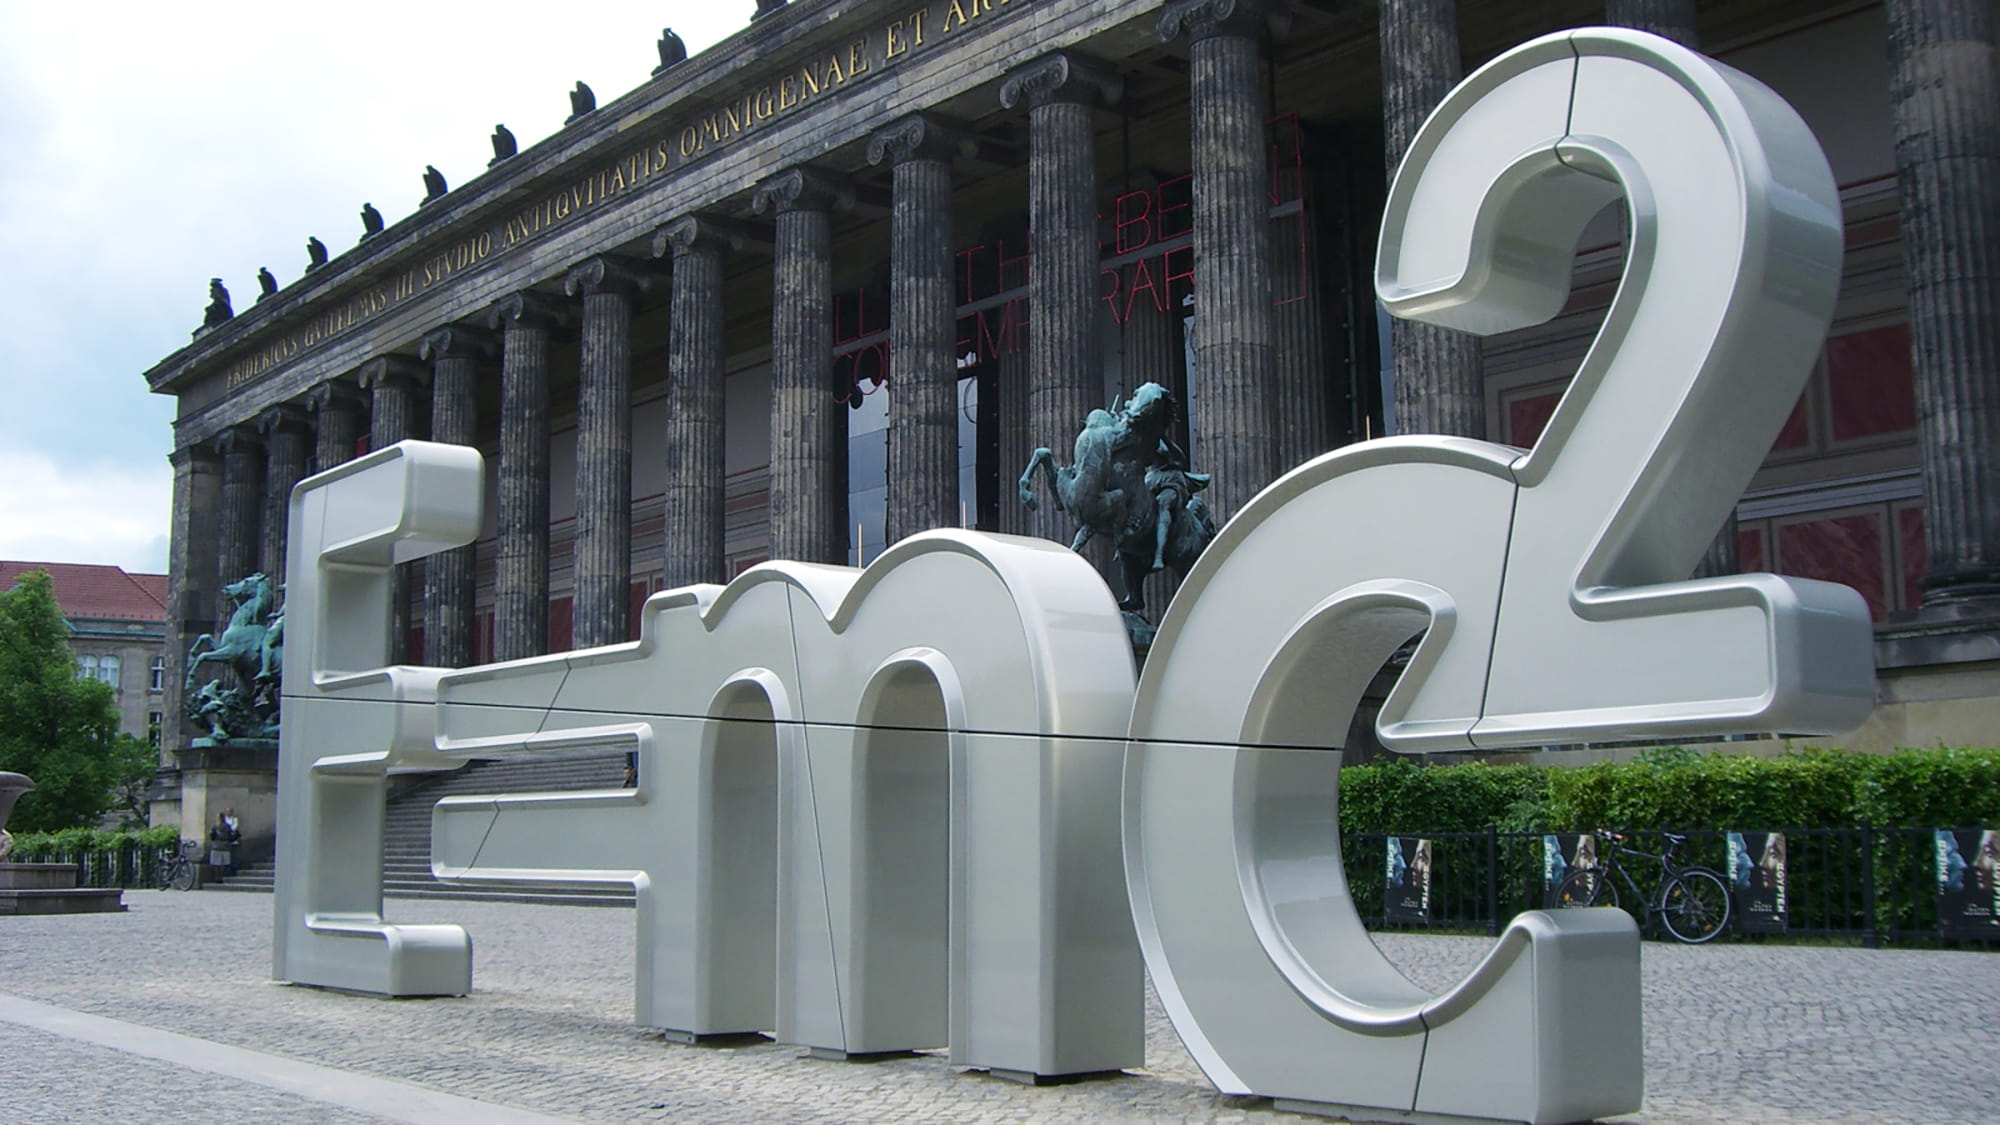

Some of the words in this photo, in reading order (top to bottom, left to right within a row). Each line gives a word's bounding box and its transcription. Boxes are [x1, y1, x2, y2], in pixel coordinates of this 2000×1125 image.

[422, 231, 491, 288] STVDIO
[501, 138, 670, 248] ANTIQVITATIS
[679, 38, 869, 158] OMNIGENAE
[885, 8, 930, 60] ET
